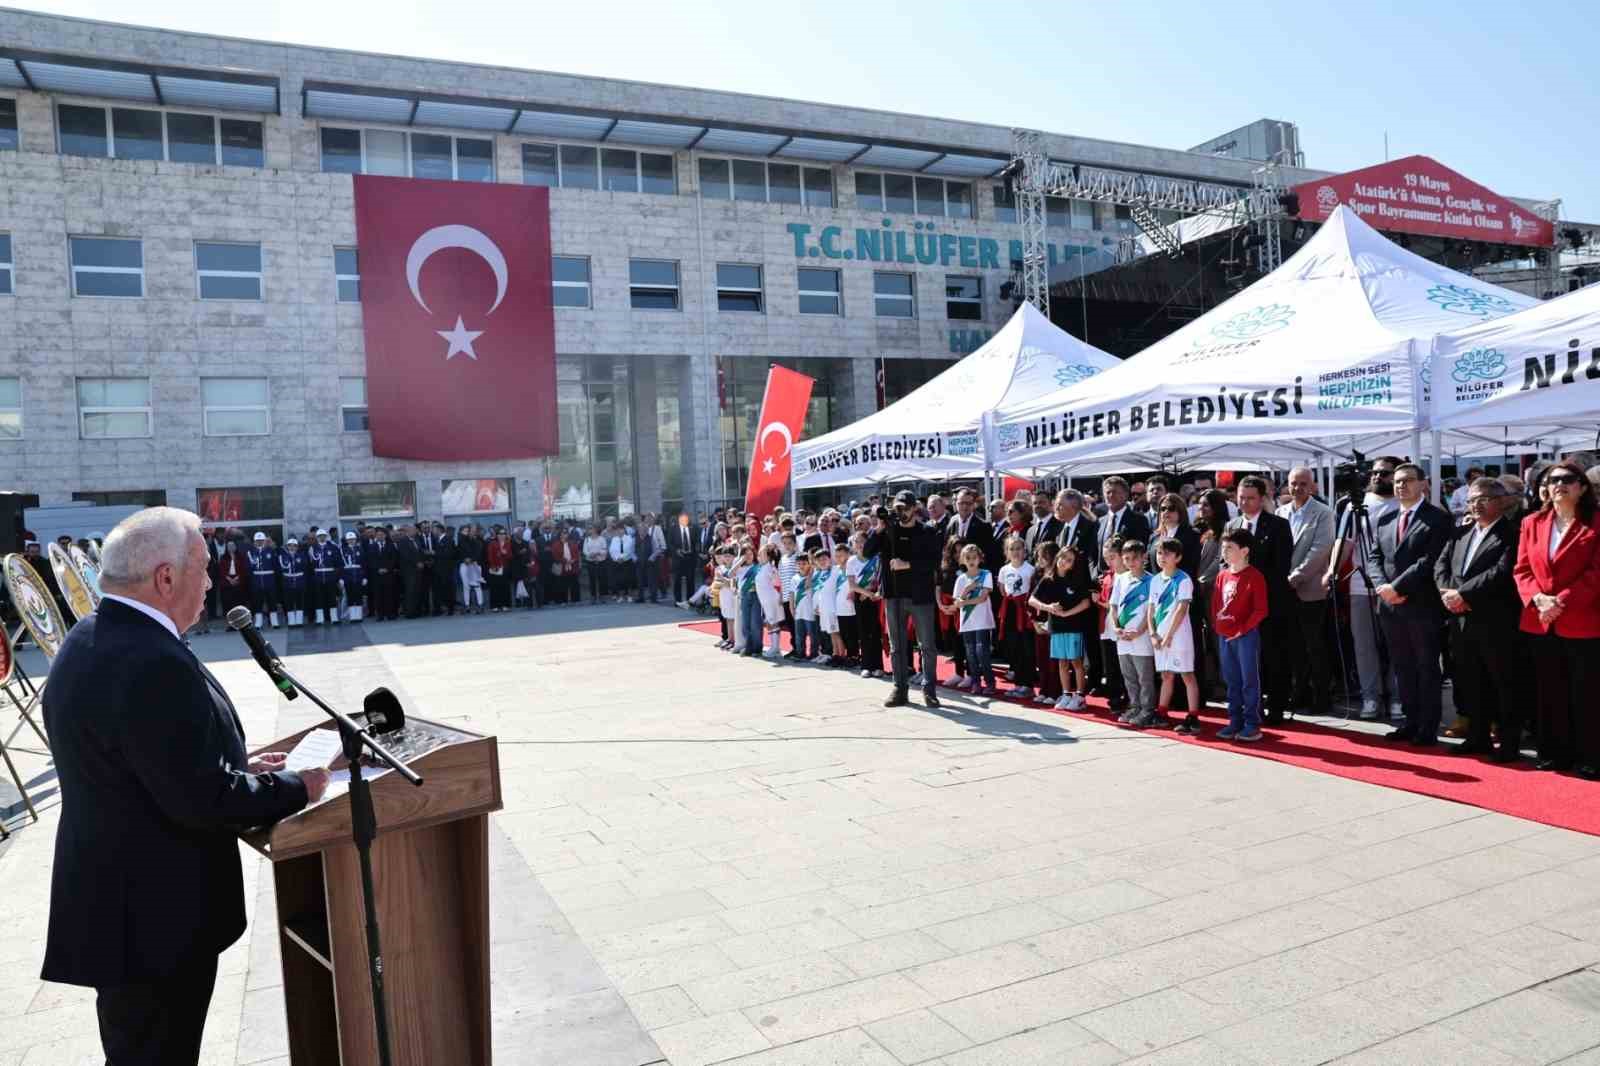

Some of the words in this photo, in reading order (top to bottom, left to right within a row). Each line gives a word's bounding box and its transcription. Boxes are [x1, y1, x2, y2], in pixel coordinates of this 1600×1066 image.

[1404, 174, 1417, 186] 19
[1348, 198, 1377, 215] Spor
[1319, 366, 1366, 382] HERKESİN
[1367, 362, 1391, 375] SESİ
[1319, 375, 1391, 397] HEPİMİZİN
[1456, 381, 1504, 393] NİLÜFER
[1318, 390, 1392, 411] NİLÜFER'İ
[1025, 409, 1121, 449] NİLÜFER
[1130, 376, 1303, 432] BELEDİYESİ
[862, 432, 942, 464] BELEDİYESİ
